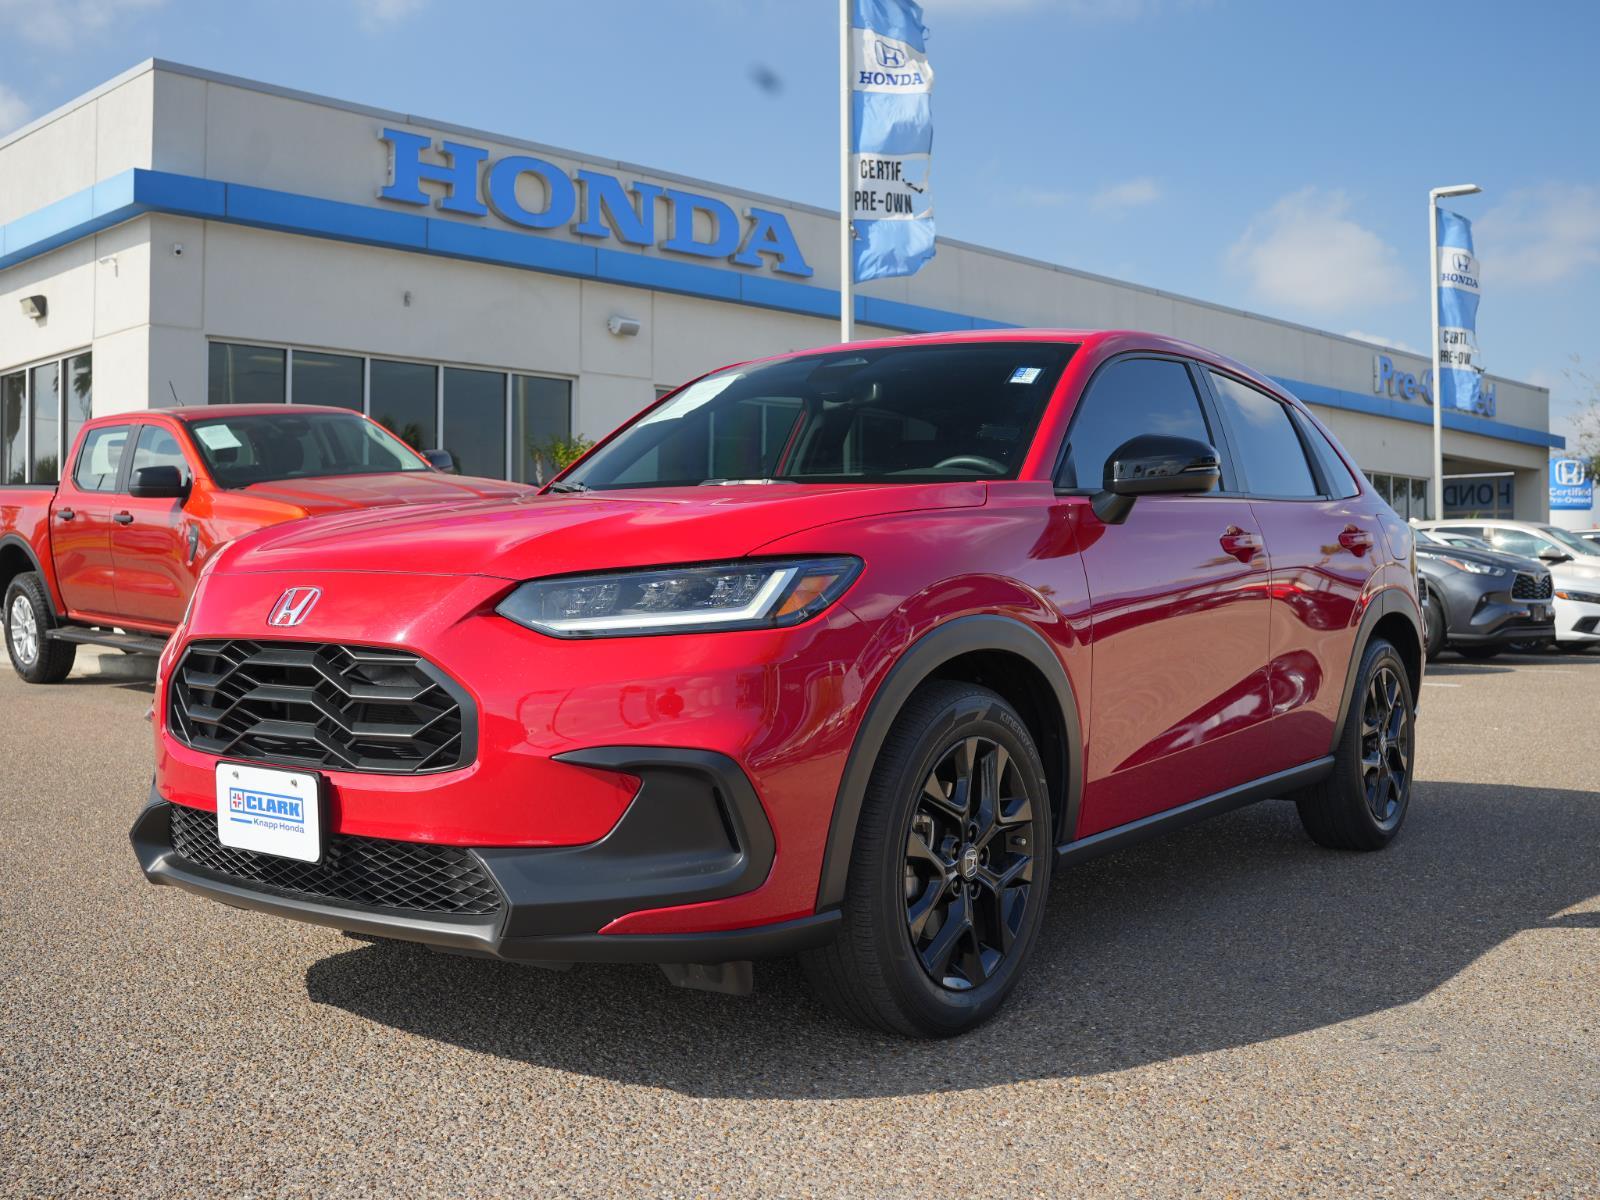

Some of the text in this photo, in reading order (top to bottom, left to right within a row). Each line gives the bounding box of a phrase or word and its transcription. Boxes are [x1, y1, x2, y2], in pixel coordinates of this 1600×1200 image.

[859, 71, 924, 86] HONDA
[376, 127, 814, 278] HONDA
[1441, 273, 1479, 289] HONDA
[246, 795, 301, 818] CLARK
[253, 818, 305, 834] Knapp Honda
